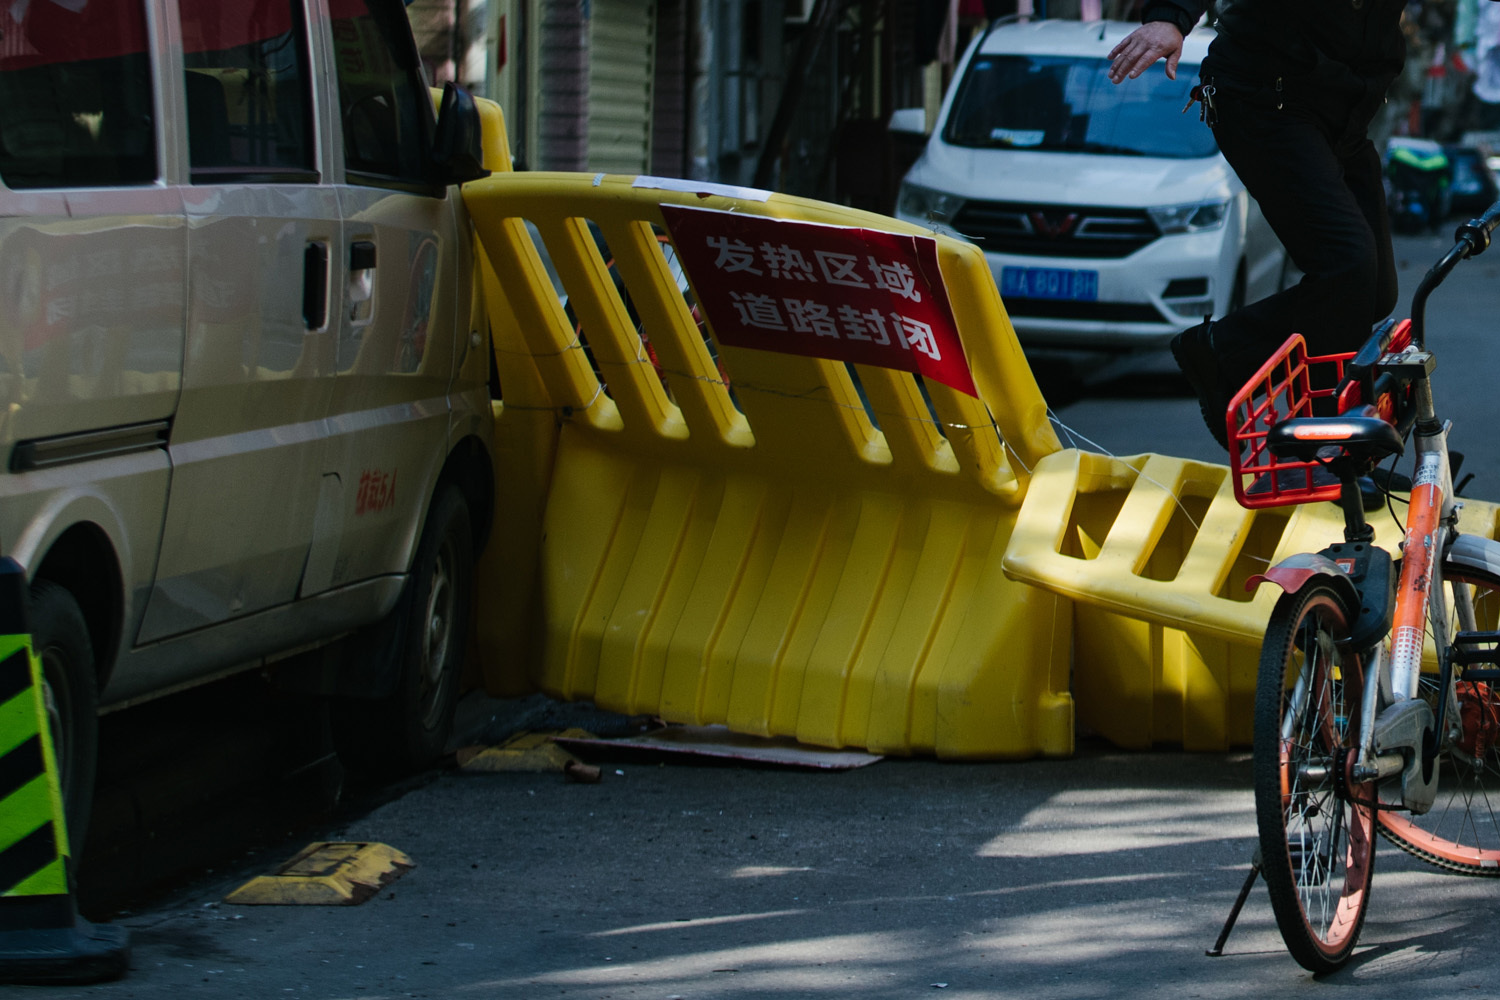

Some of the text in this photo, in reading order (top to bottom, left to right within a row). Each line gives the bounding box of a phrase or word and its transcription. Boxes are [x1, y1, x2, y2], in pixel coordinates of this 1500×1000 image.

[705, 235, 922, 303] 发热区域
[728, 290, 942, 362] 道路封闭
